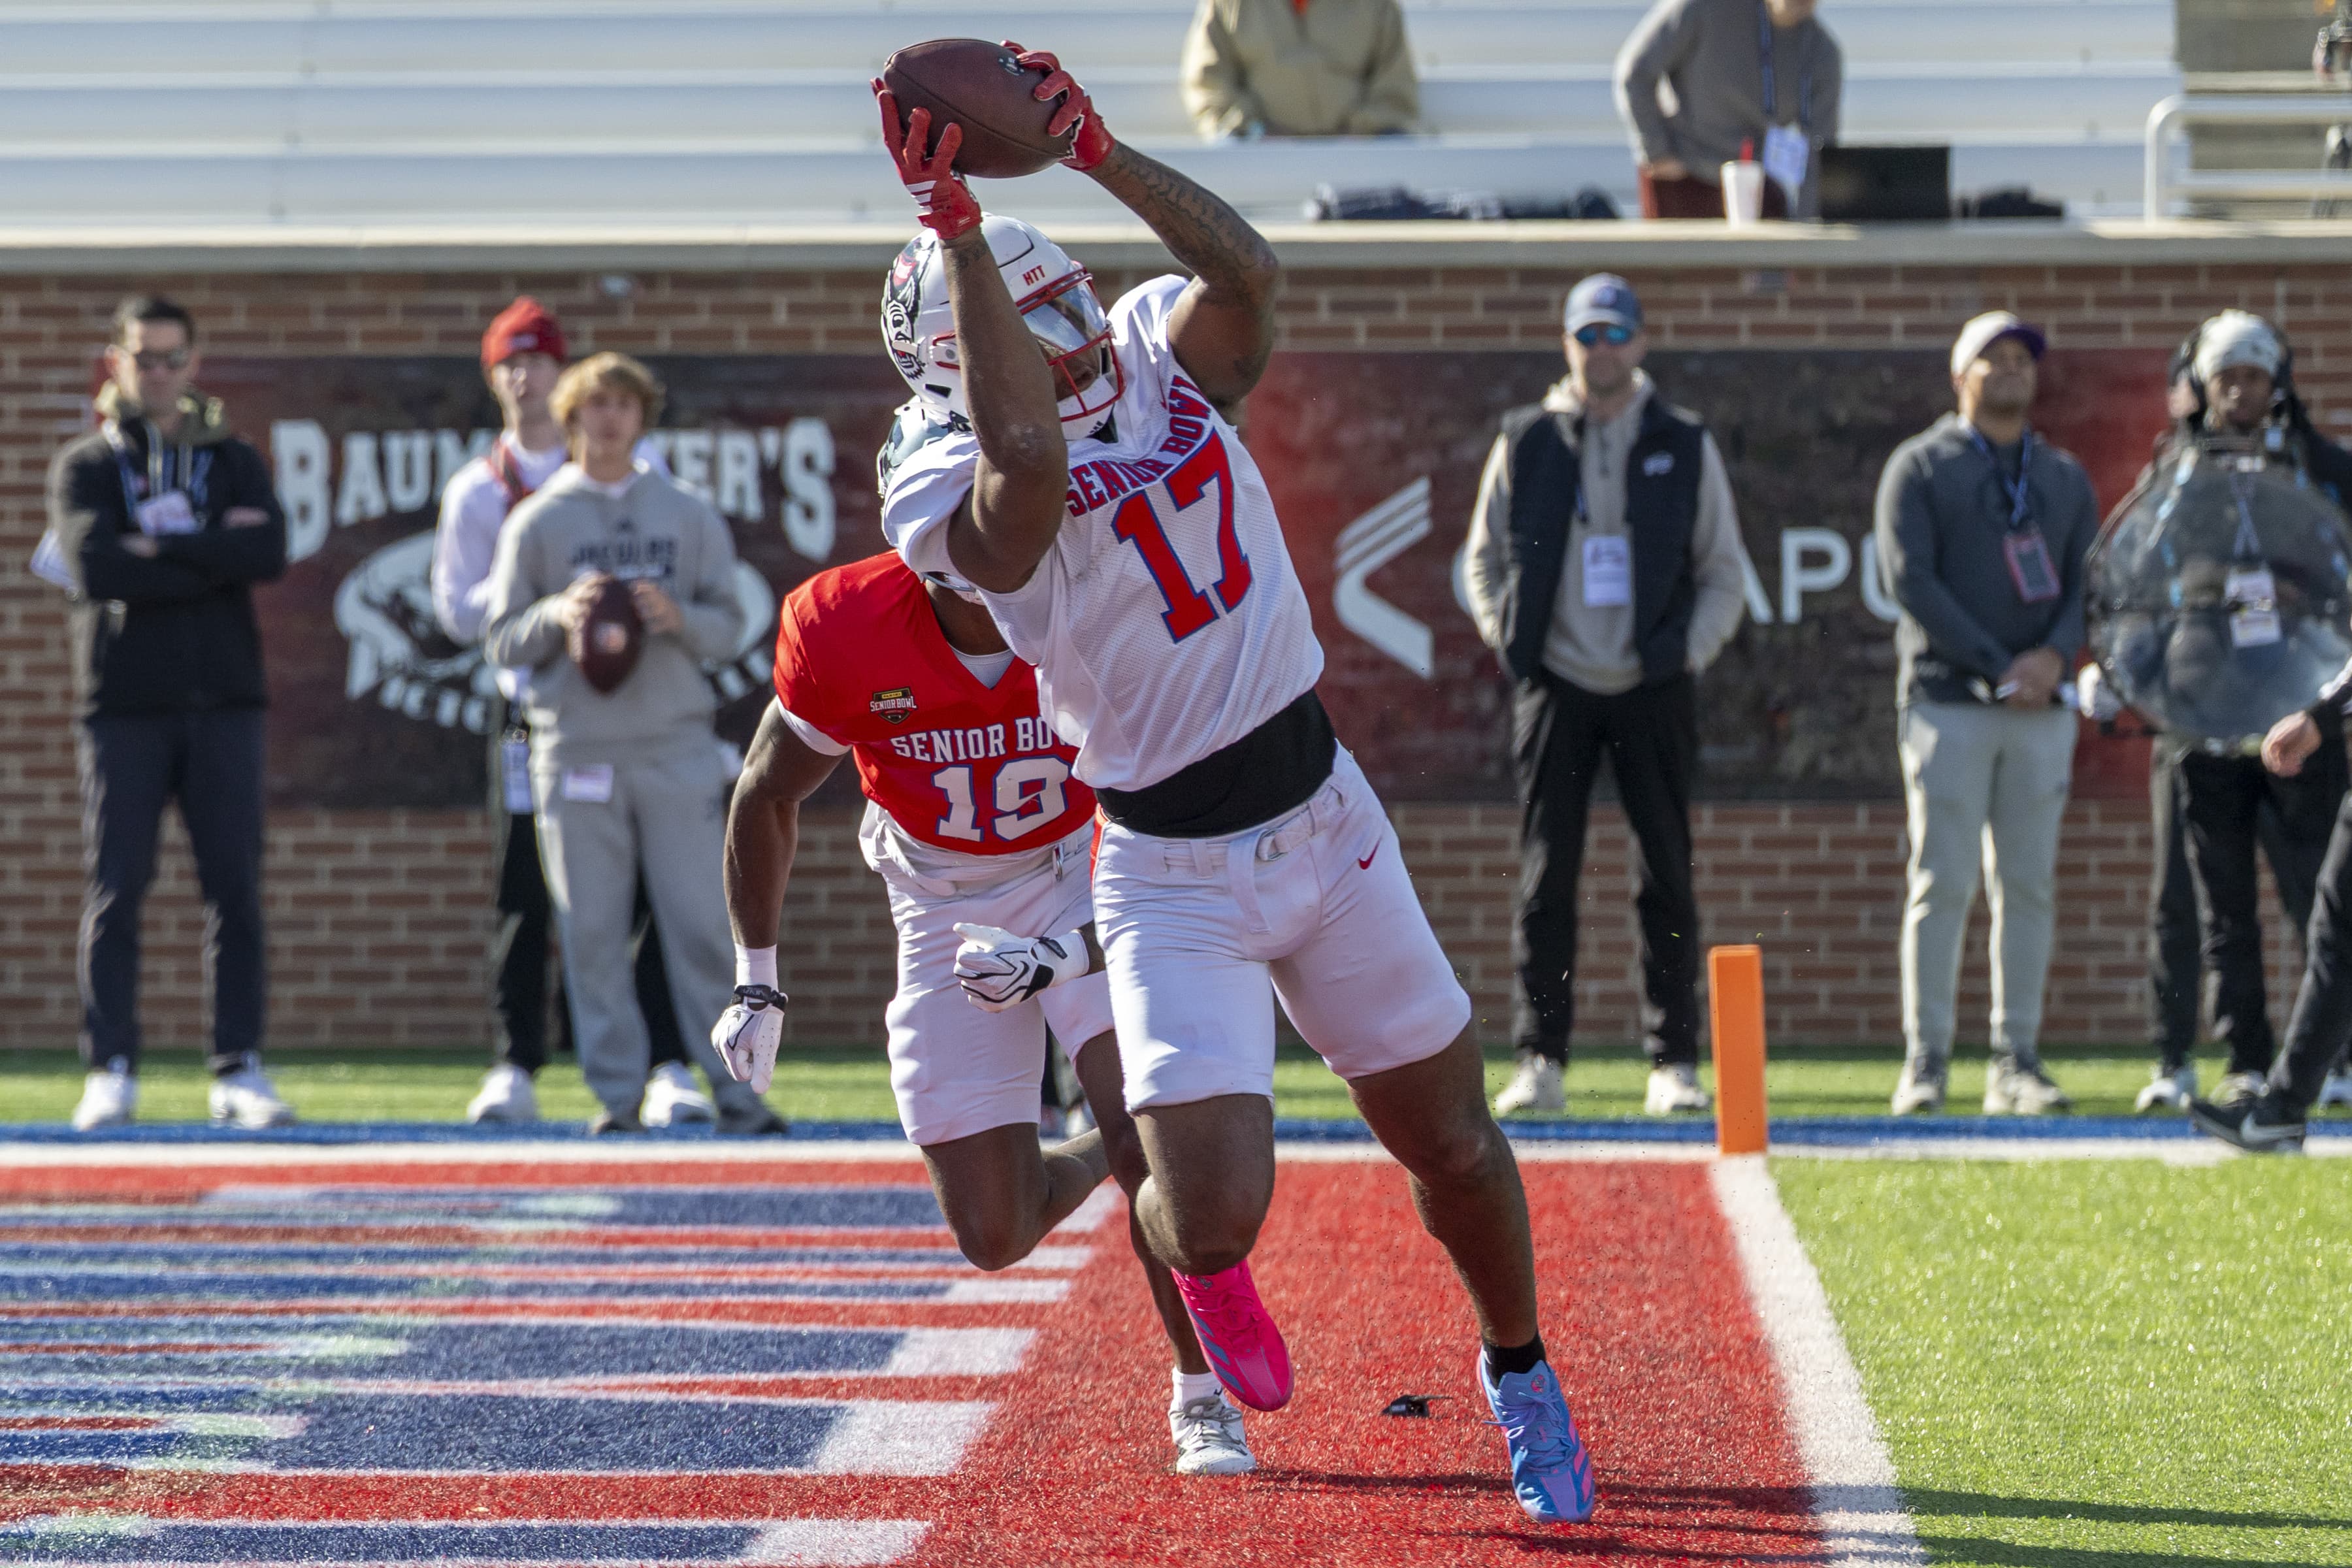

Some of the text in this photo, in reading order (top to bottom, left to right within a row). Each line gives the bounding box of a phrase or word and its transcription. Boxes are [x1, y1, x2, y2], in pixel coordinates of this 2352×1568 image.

[1022, 265, 1045, 286] HTT
[1111, 426, 1253, 644] 17
[870, 699, 896, 711] SENIOR
[897, 696, 917, 709] BOWL
[890, 715, 1073, 763] SENIOR BO
[931, 754, 1073, 842] 19
